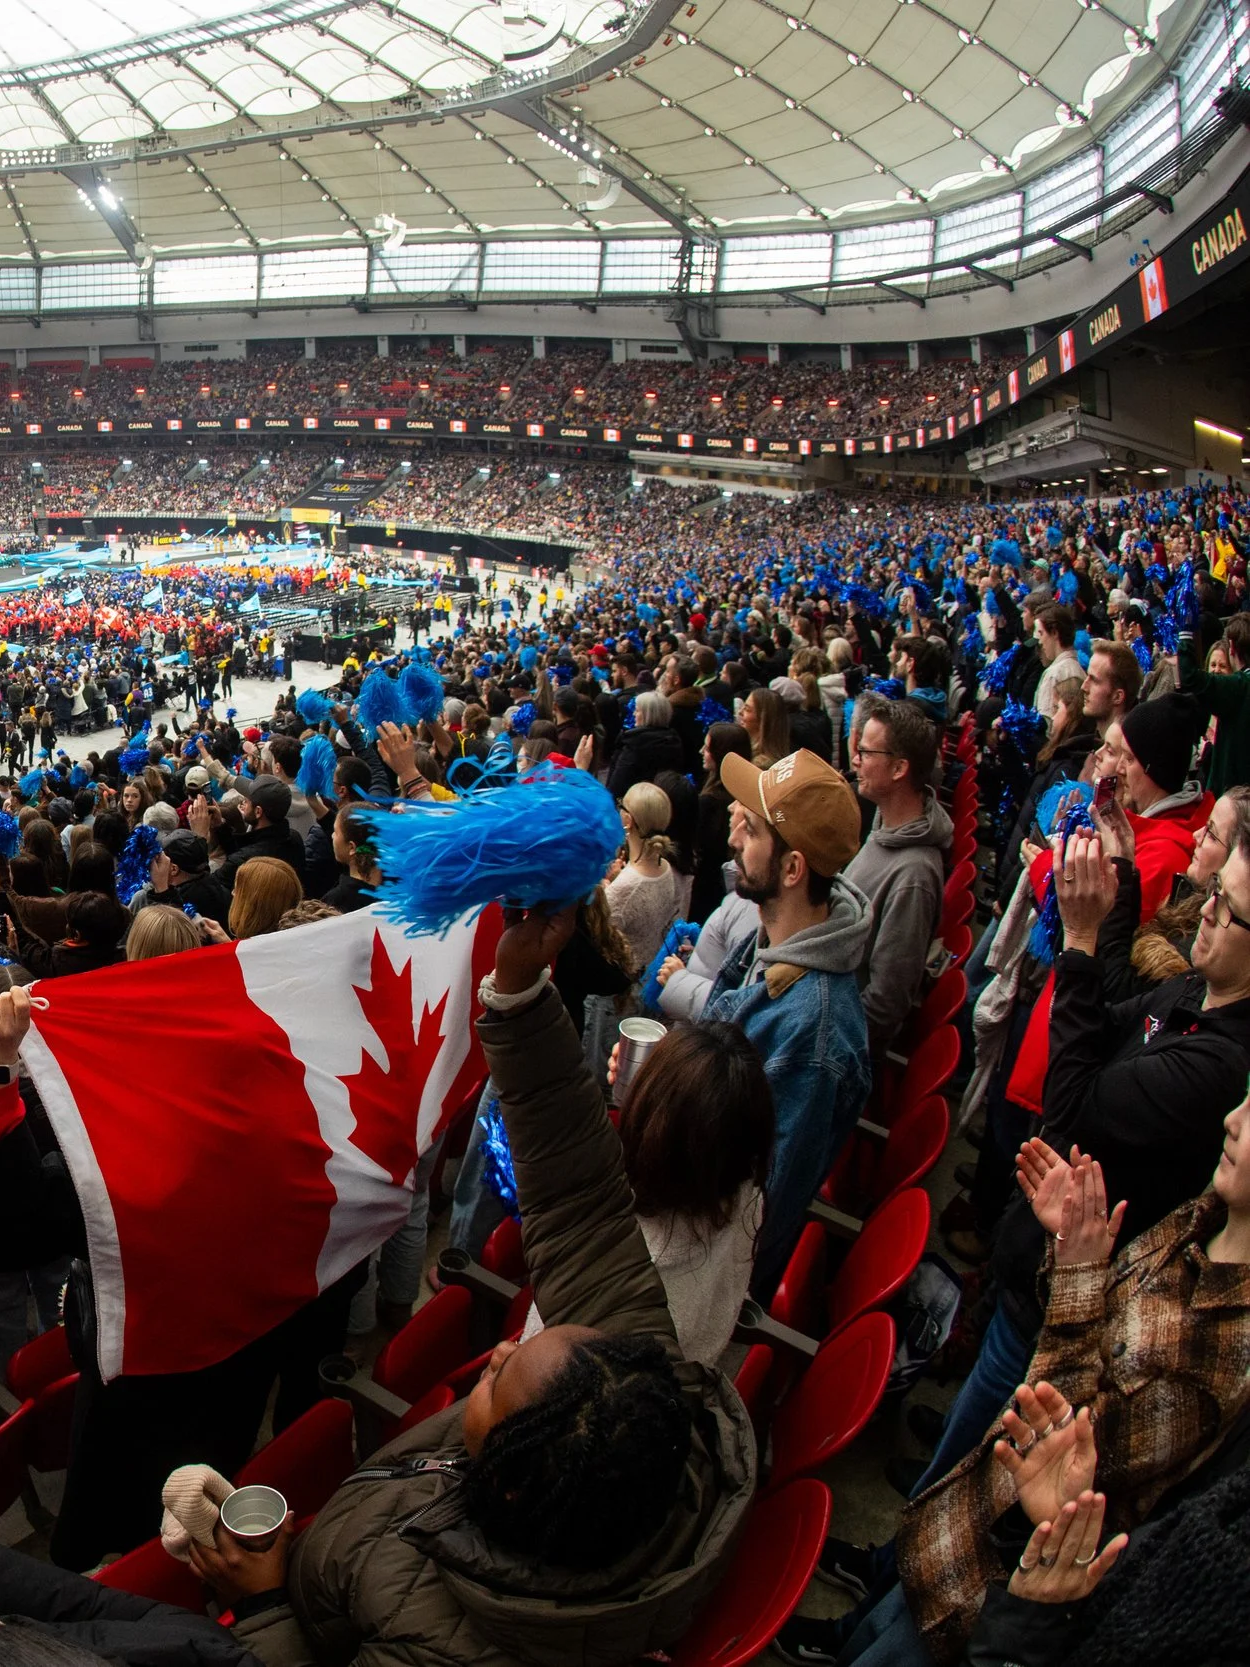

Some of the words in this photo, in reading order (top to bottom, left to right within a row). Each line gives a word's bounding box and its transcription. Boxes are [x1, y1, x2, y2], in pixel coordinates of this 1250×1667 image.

[1192, 207, 1248, 275] CANADA
[1088, 304, 1121, 345] CANADA
[1027, 356, 1048, 385] CANADA
[334, 420, 360, 428] CANADA
[407, 422, 434, 430] CANADA
[483, 425, 511, 433] CANADA
[561, 429, 588, 438] CANADA
[143, 687, 154, 699] A3
